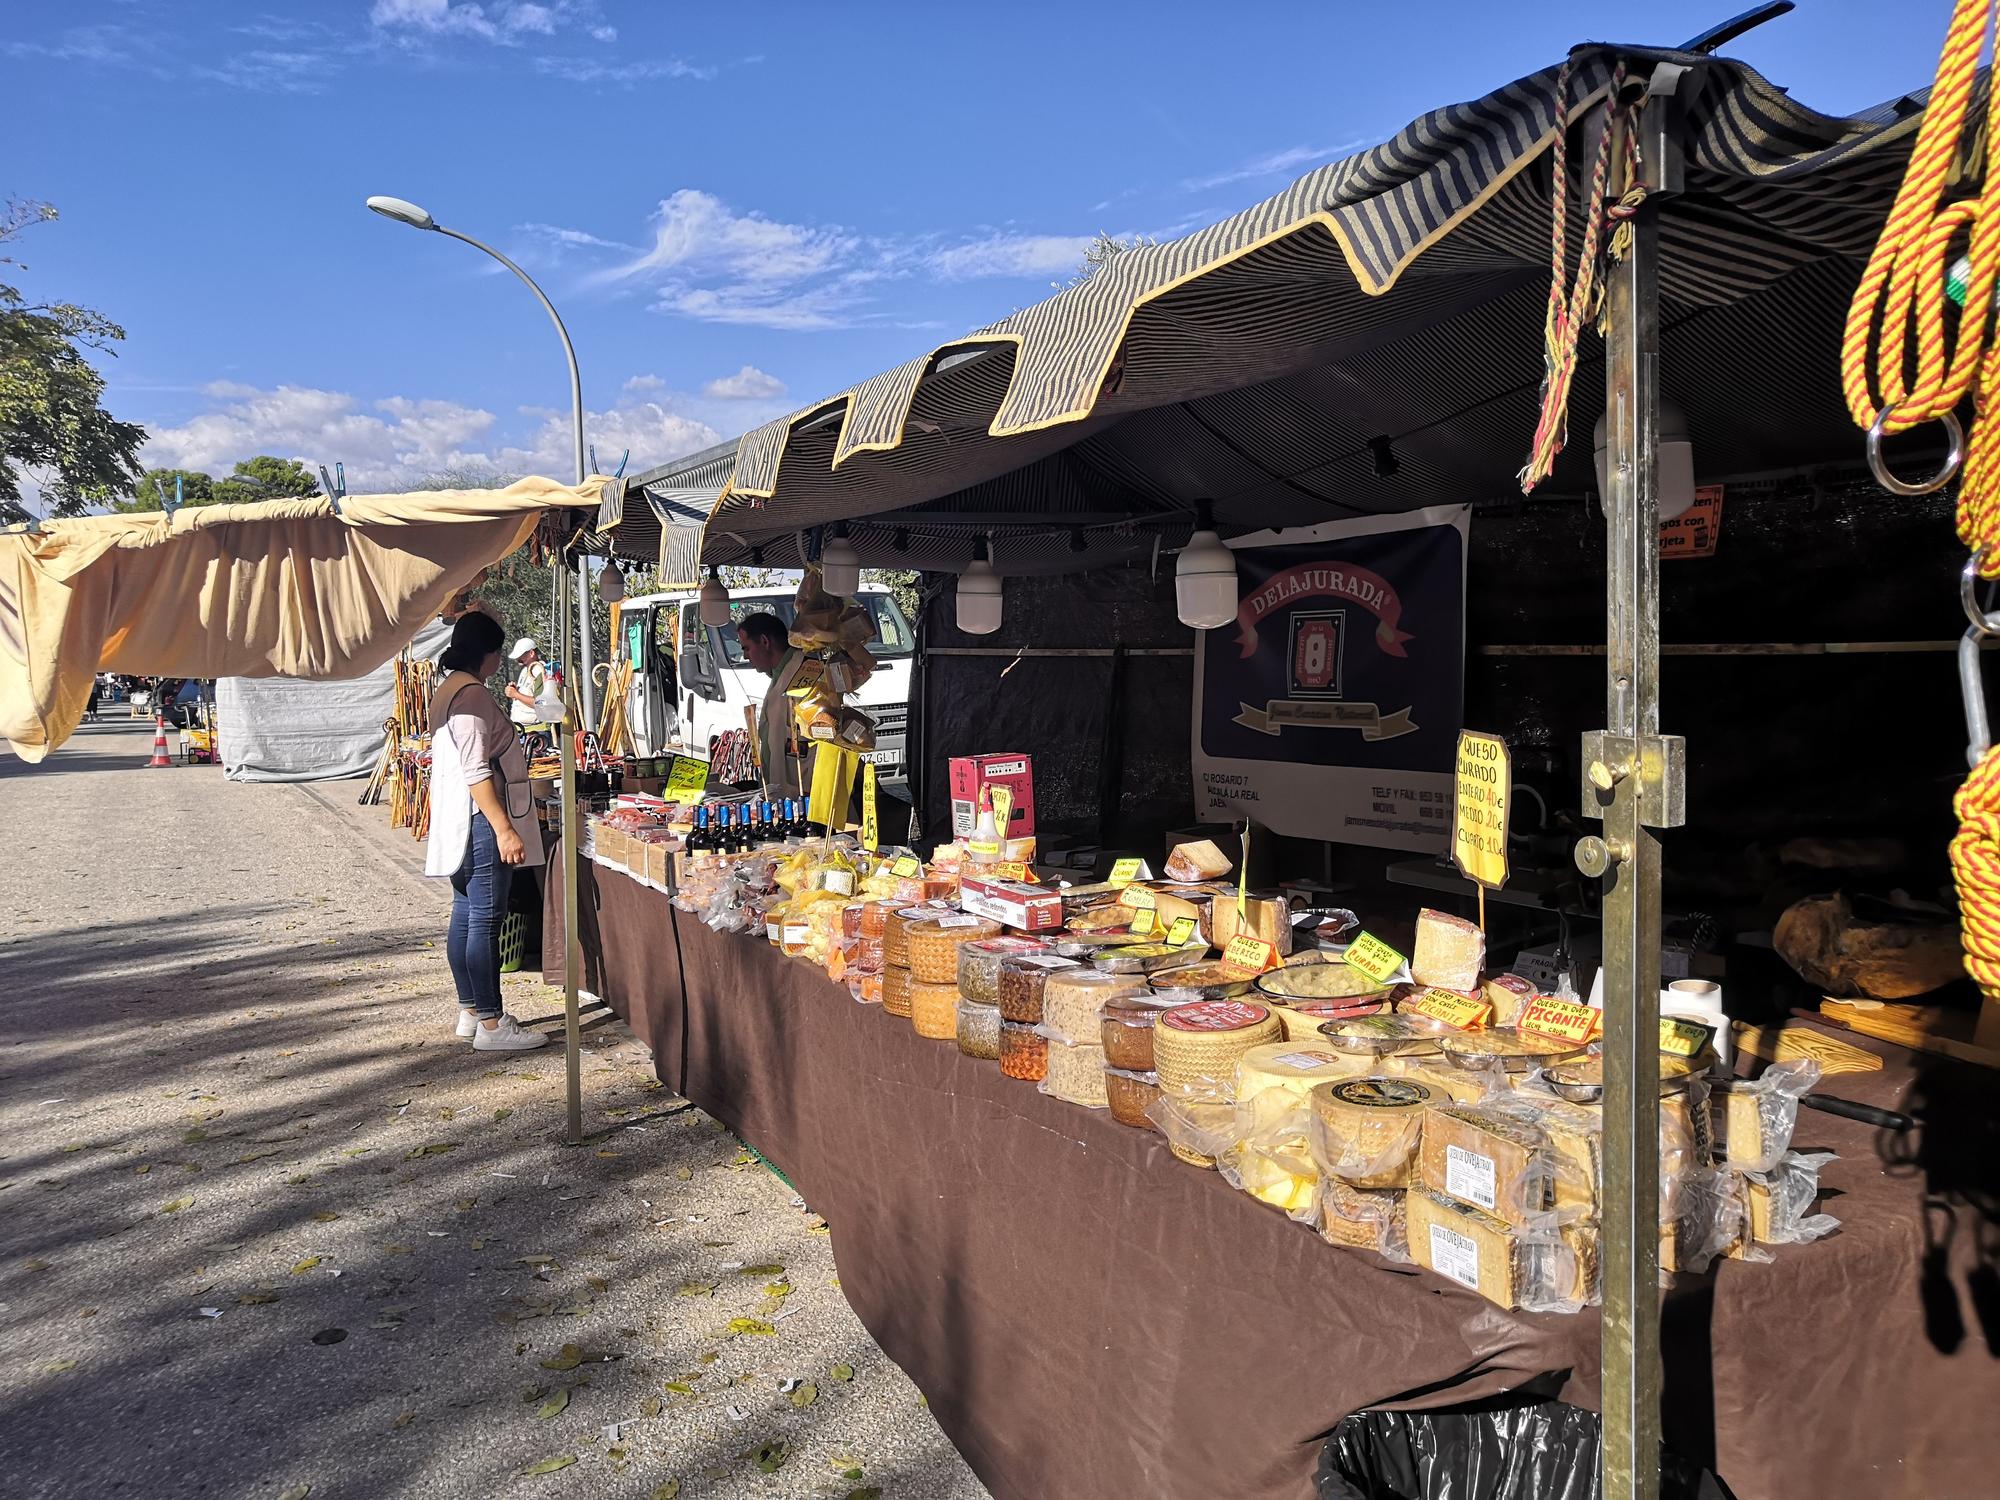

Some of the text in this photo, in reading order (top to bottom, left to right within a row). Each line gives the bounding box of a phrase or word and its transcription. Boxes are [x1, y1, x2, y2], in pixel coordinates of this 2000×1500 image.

[1659, 517, 1705, 531] gos con
[1251, 570, 1386, 615] DELAJURADA
[1464, 737, 1497, 761] QUESO
[1210, 774, 1242, 785] ROSARIO
[1243, 776, 1248, 785] 7
[1458, 757, 1497, 784] CURADO
[1240, 790, 1261, 801] REAL
[1459, 780, 1485, 803] ENTERO
[1459, 804, 1484, 825] MEDIO
[1237, 936, 1260, 950] QUESO
[1347, 949, 1382, 975] CURADO
[1425, 995, 1438, 1003] CON
[1431, 989, 1454, 1001] QUESO
[1417, 1001, 1463, 1025] PICANTE
[1526, 1006, 1590, 1029] PICANTE
[1536, 998, 1559, 1009] QUESO
[1571, 1006, 1590, 1016] OVEJA
